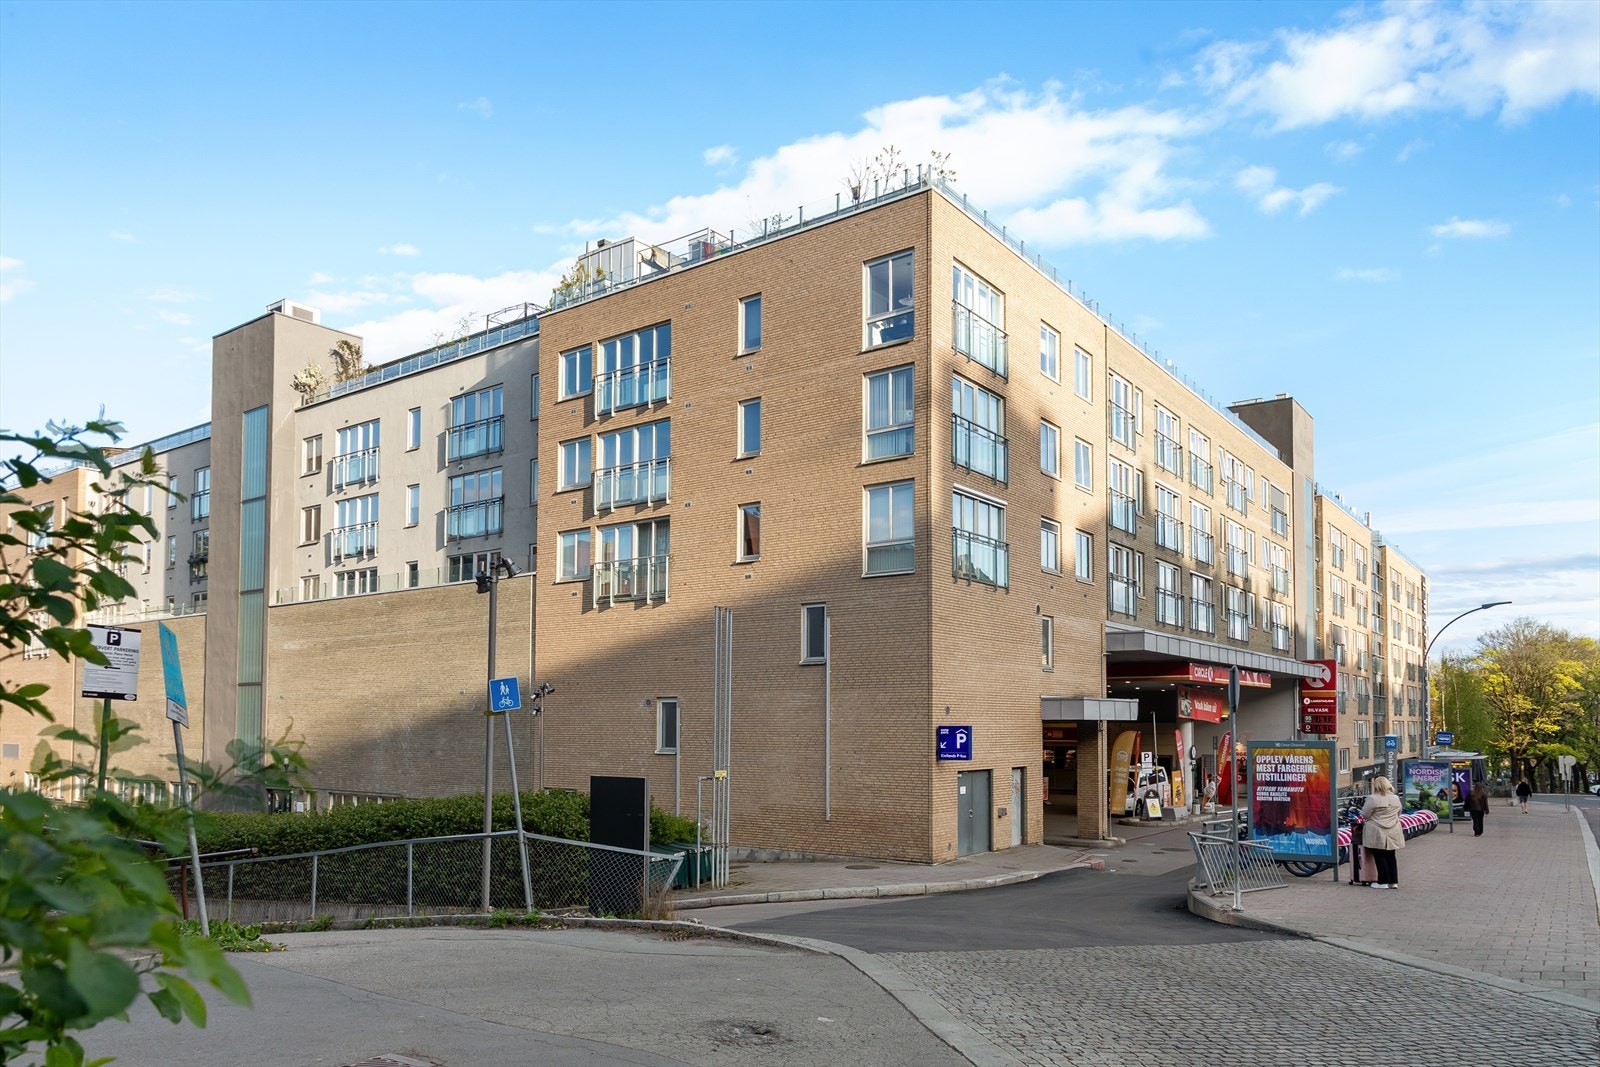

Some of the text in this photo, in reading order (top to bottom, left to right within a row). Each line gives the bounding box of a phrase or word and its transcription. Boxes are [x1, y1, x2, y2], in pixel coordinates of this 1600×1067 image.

[110, 633, 119, 643] P
[1194, 667, 1208, 678] CIRCLE
[956, 733, 967, 749] P
[1143, 752, 1150, 761] P
[1256, 754, 1314, 764] OPPLEV VÅRENS
[1256, 764, 1317, 773] MEST FARGERIKE
[1256, 773, 1307, 782] UTSTILLINGER
